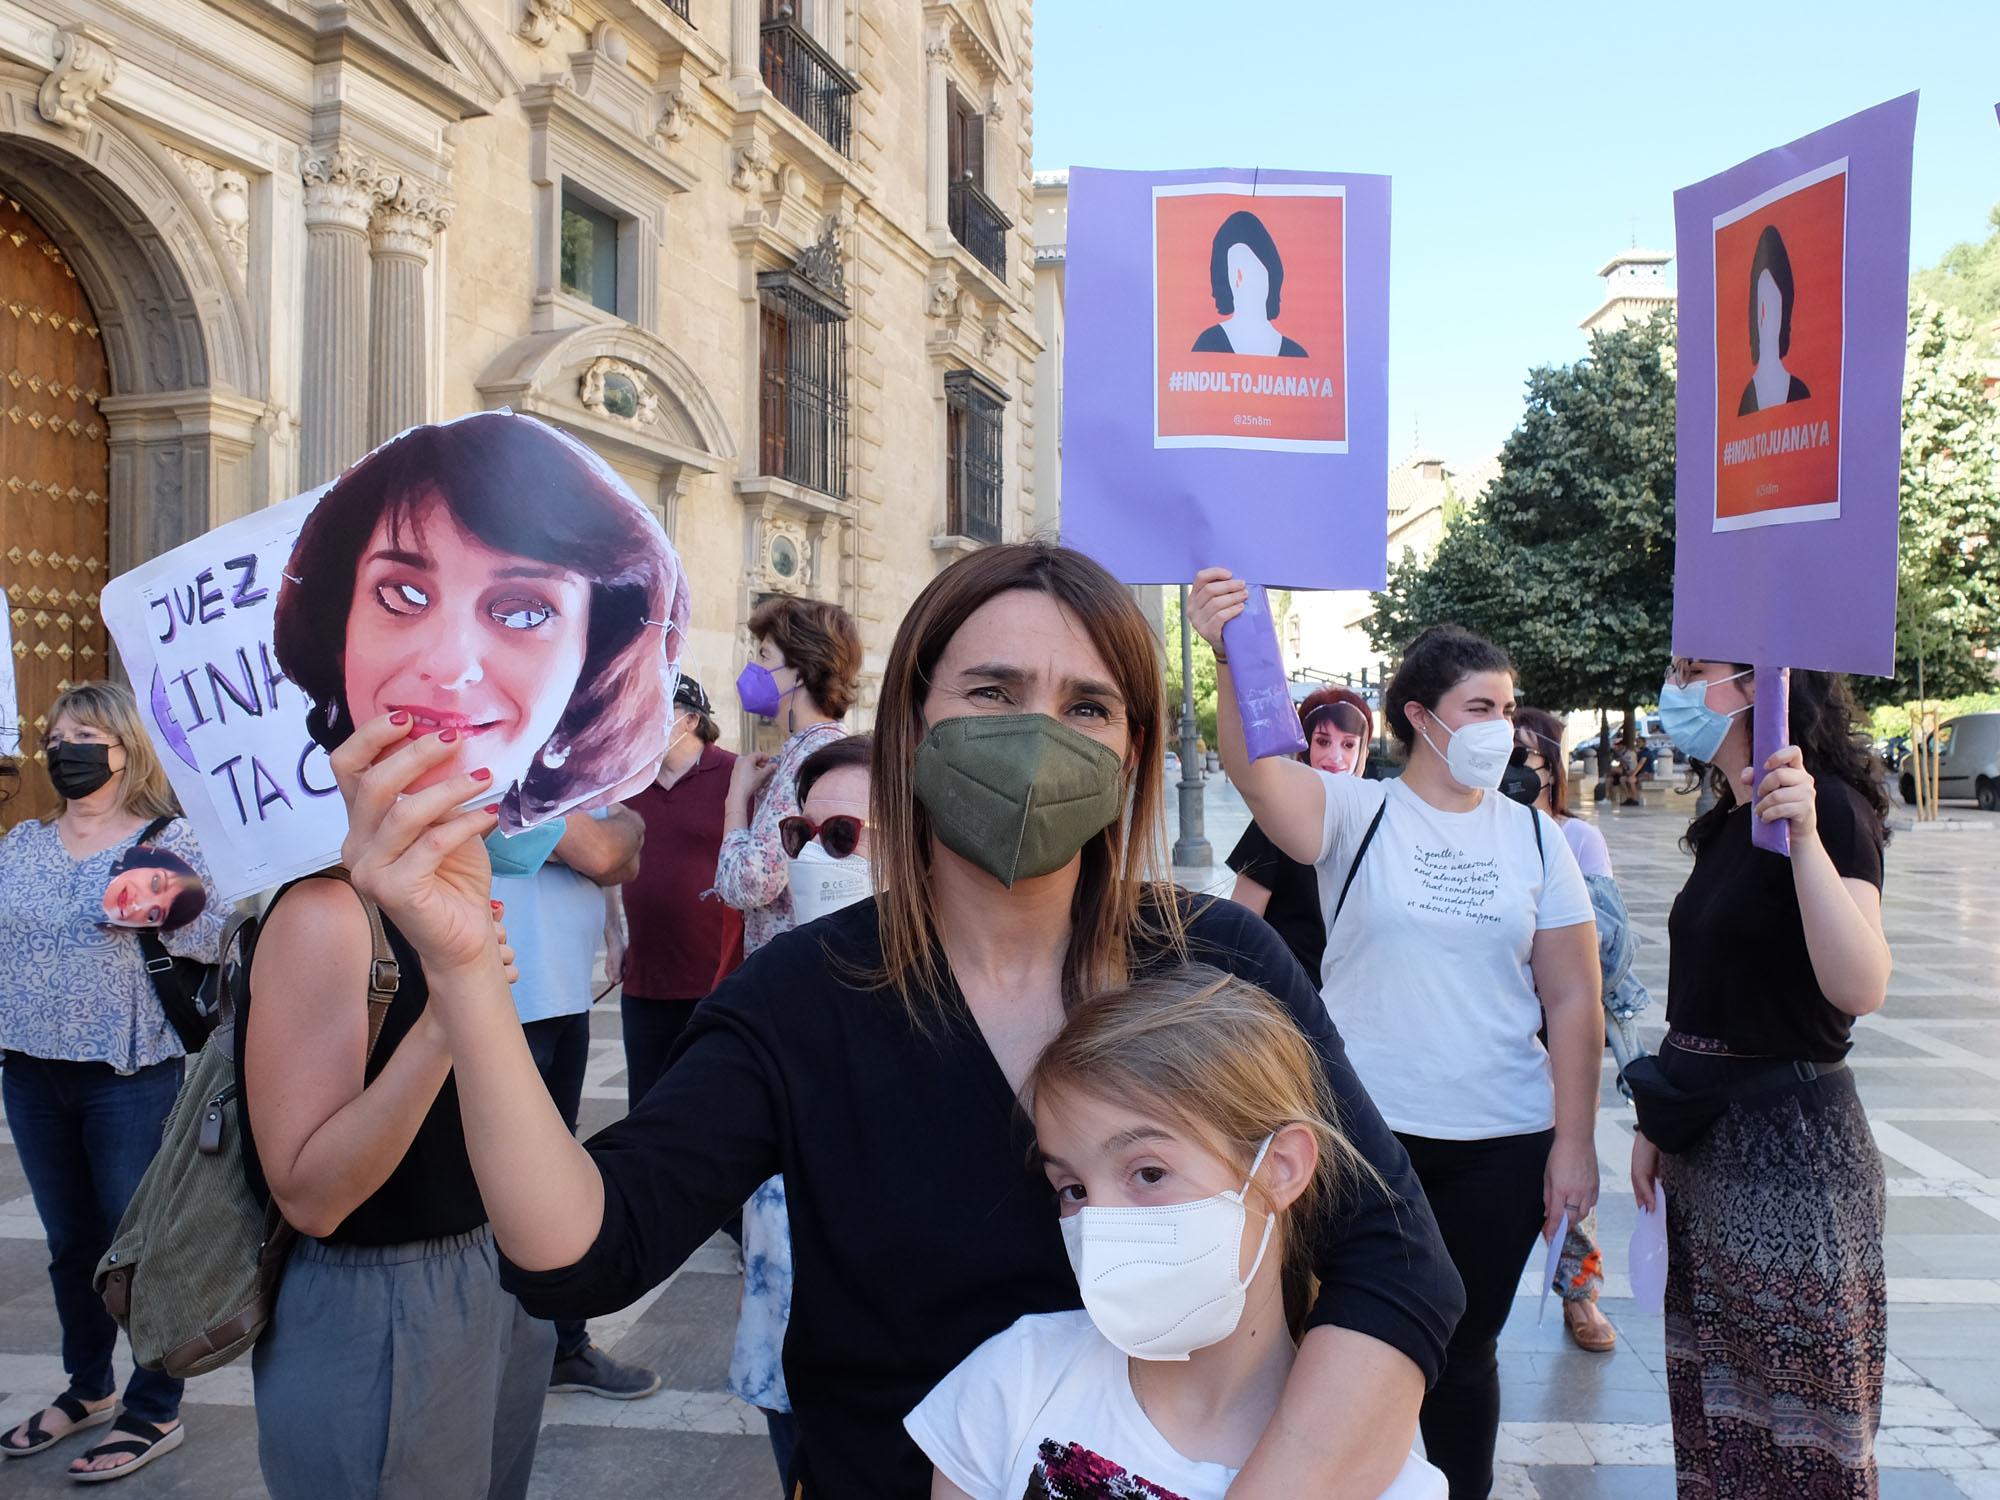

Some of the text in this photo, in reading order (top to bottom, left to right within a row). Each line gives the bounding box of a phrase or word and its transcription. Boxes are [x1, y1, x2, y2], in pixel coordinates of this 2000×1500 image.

[1168, 370, 1334, 398] #INDULTOJUANAYA
[1233, 414, 1272, 427] @25n8m
[1723, 420, 1830, 466] #INDULTOJUANAYA
[150, 553, 270, 644] JUEZ
